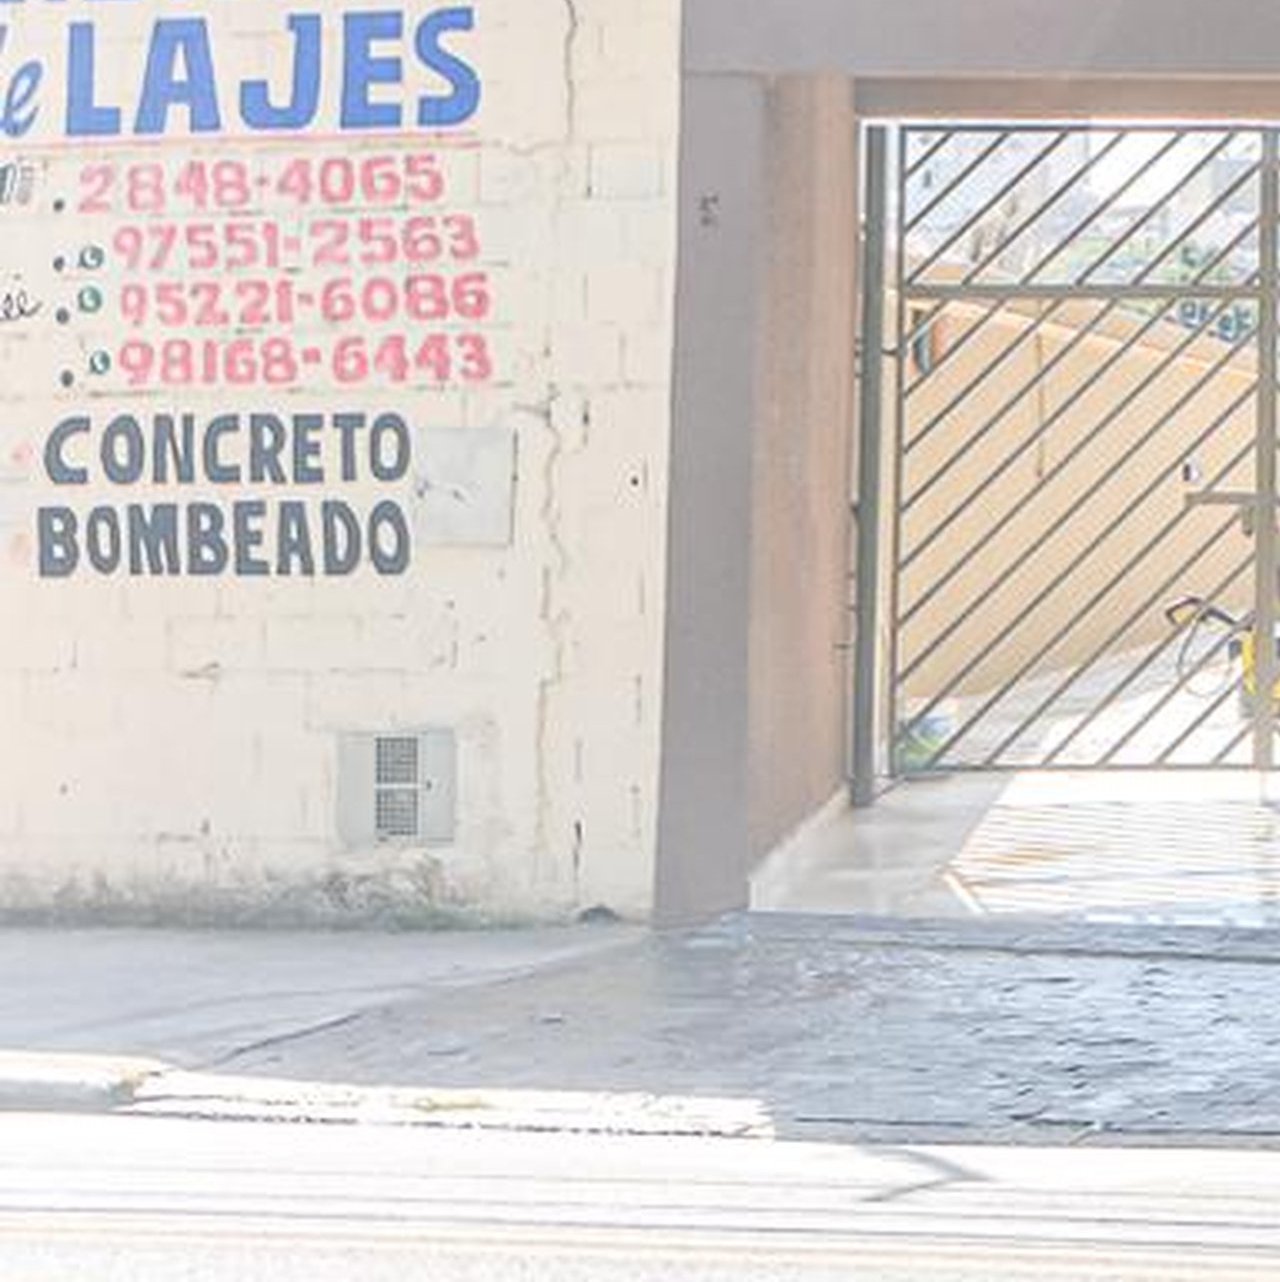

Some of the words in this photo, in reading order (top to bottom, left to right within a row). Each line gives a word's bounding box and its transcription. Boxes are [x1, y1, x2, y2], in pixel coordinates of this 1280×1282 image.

[66, 8, 481, 136] LAJES
[77, 155, 444, 213] 2848-4065
[113, 215, 480, 269] 97551-2563
[118, 334, 491, 384] 98168-6443
[44, 412, 411, 484] CONCRETO
[38, 501, 411, 577] BOMBEADO
